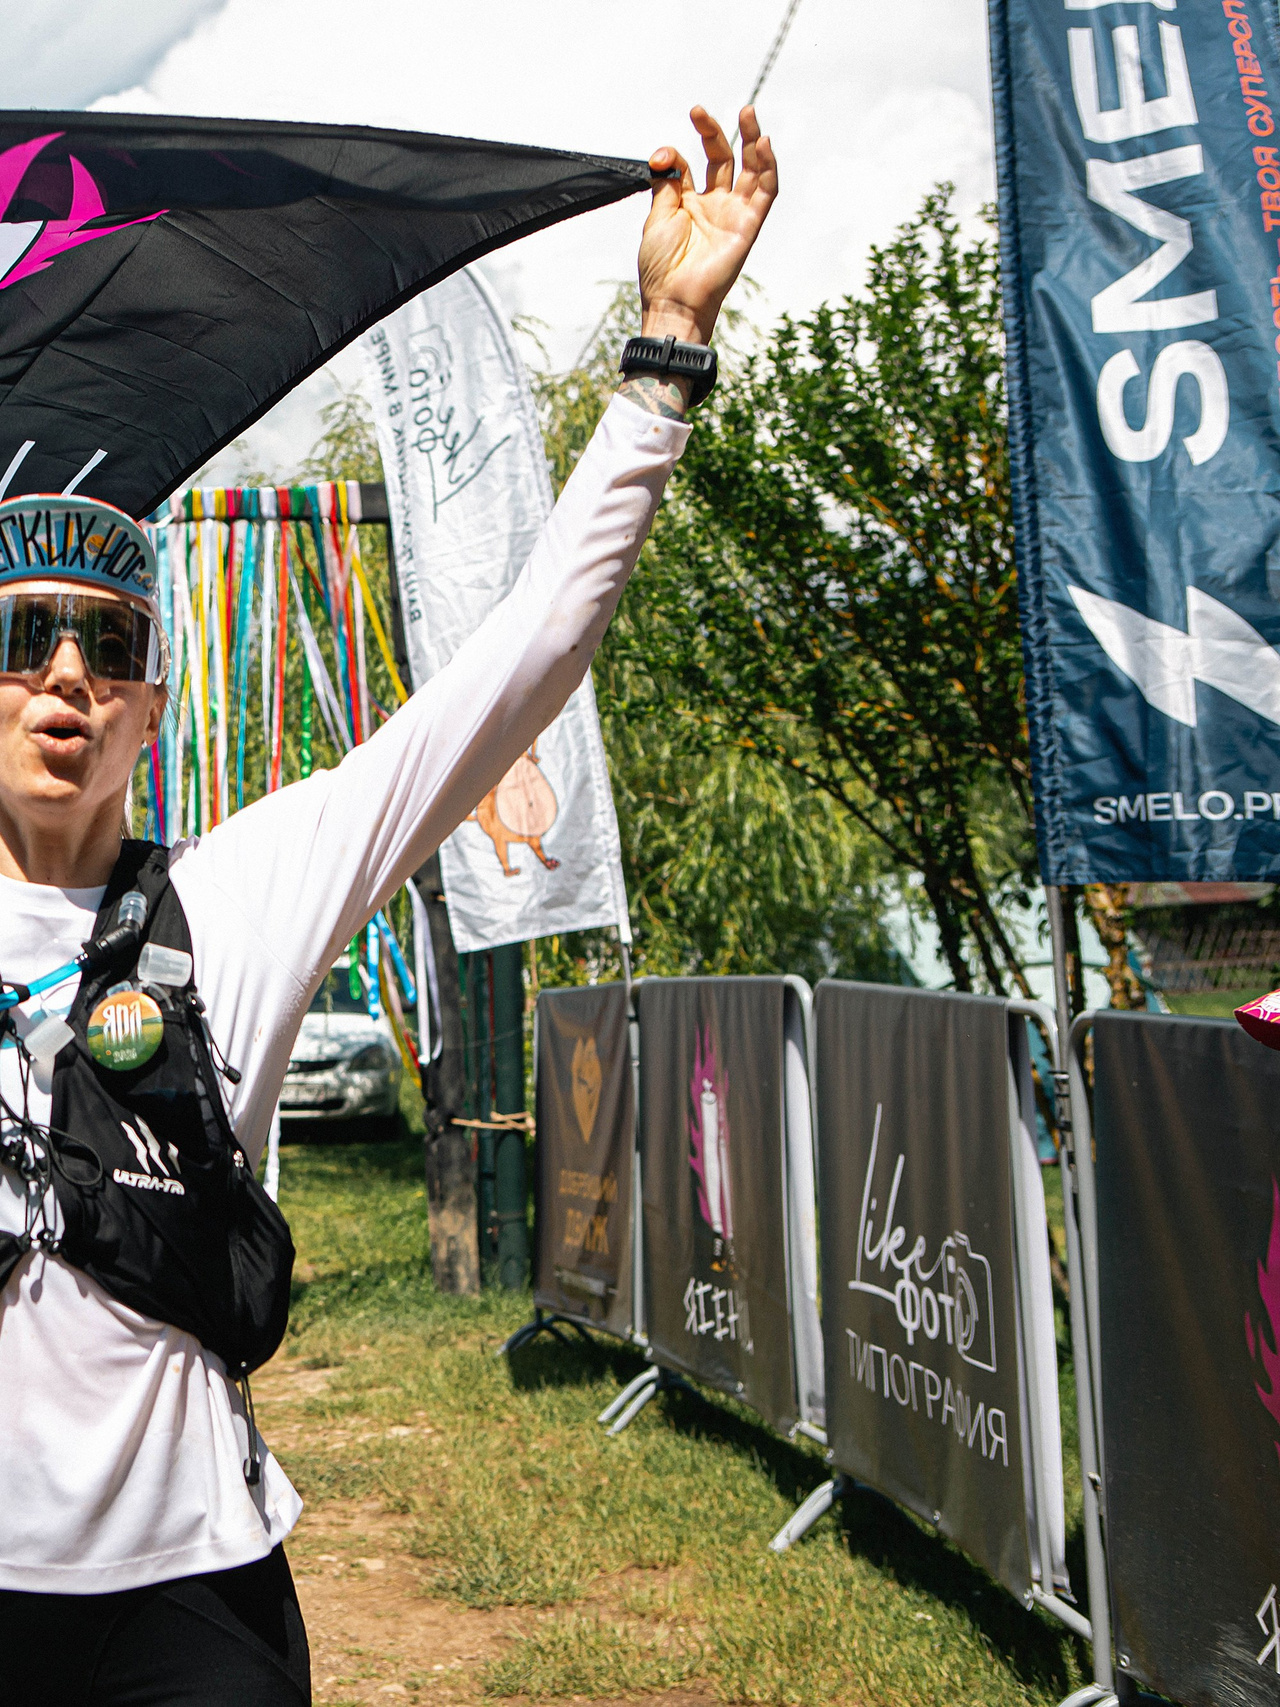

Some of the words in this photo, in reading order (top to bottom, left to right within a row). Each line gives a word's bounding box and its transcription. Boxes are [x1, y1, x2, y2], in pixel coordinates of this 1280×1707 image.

[1064, 0, 1231, 467] SME
[91, 523, 147, 583] НОГ
[1093, 789, 1280, 826] SMELO.P
[849, 1103, 950, 1290] Like
[846, 1328, 1009, 1467] ТИПОГРАФИЯ
